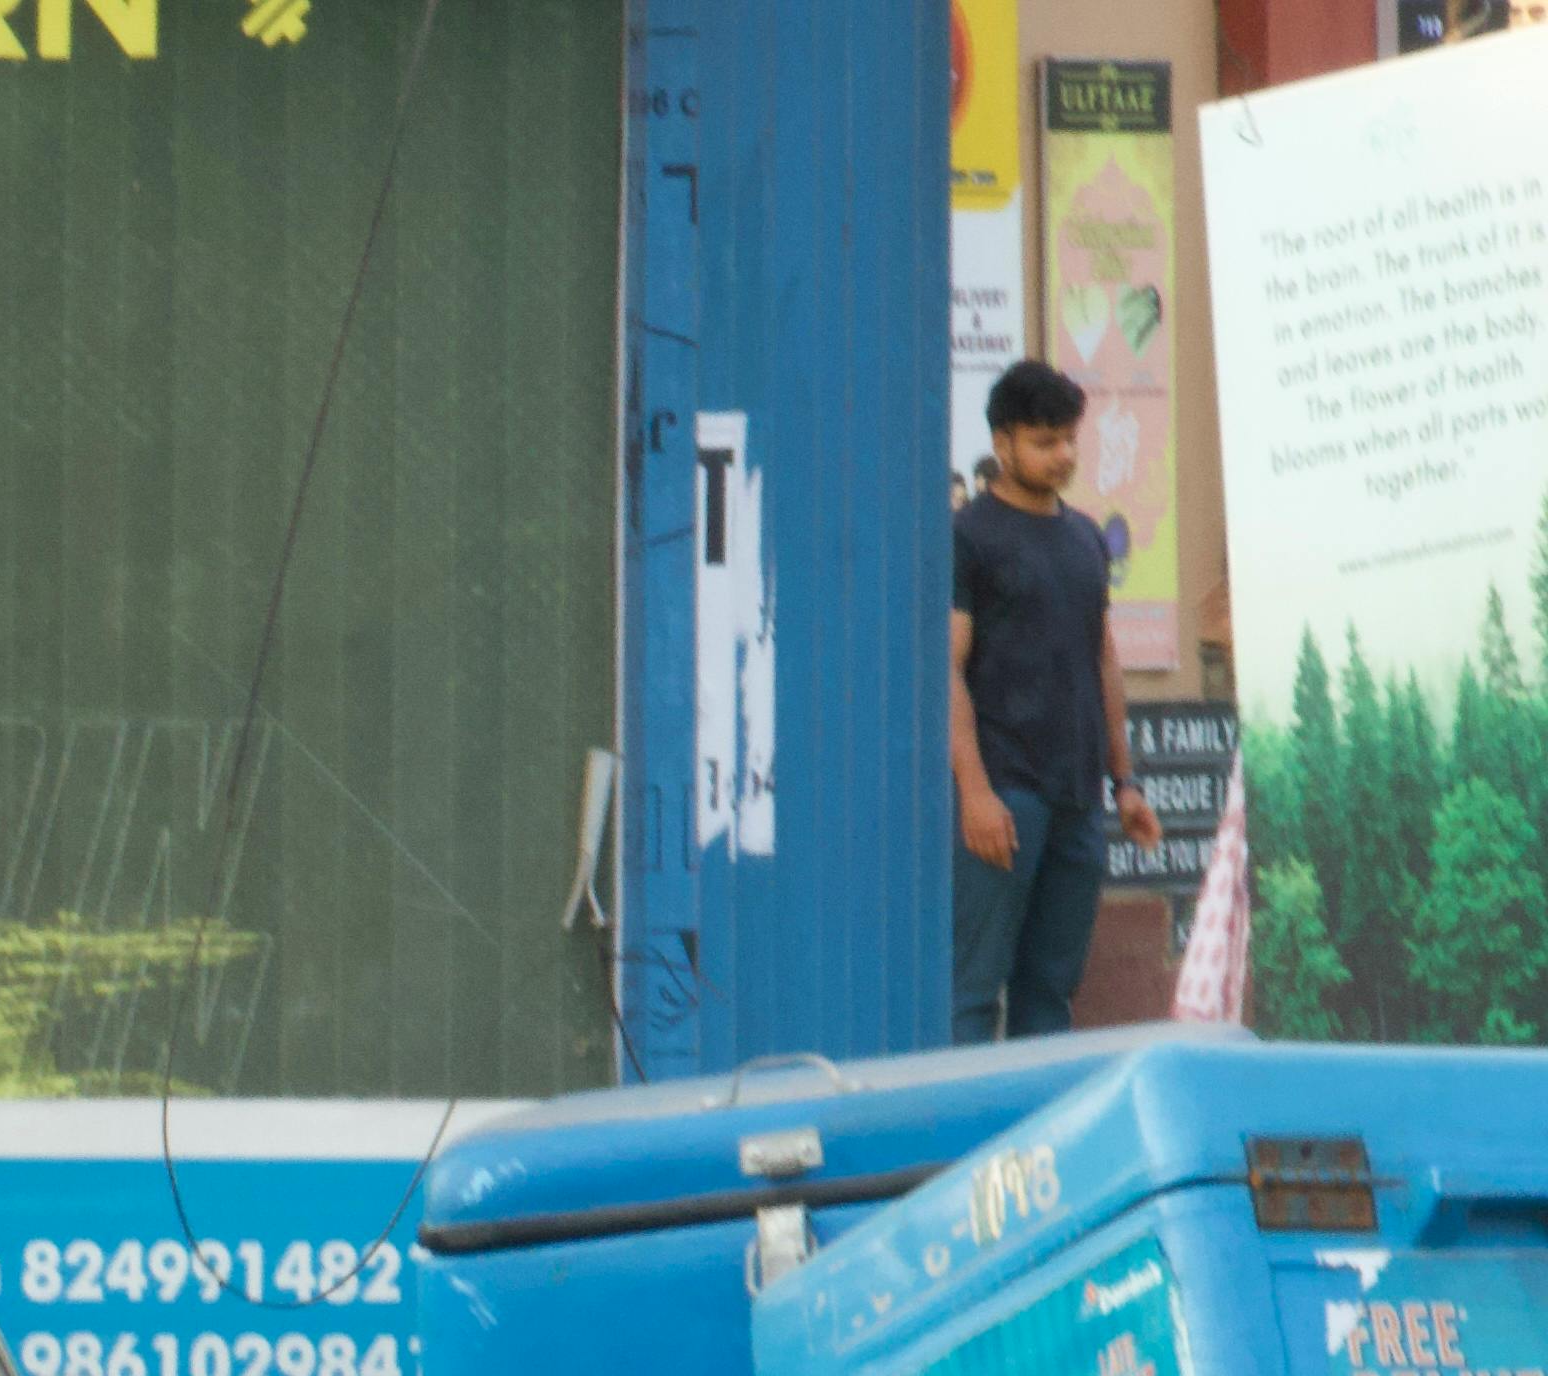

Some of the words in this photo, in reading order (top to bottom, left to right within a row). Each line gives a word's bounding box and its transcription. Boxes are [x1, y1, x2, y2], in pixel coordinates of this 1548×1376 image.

[1313, 218, 1356, 250] root
[1363, 205, 1385, 239] of
[1392, 195, 1420, 231] all
[1425, 181, 1493, 219] health
[1499, 182, 1517, 207] is
[1521, 176, 1544, 199] in
[1264, 274, 1300, 304] the
[1374, 247, 1412, 279] The
[1417, 232, 1470, 268] trunk
[1476, 220, 1500, 255] of
[1505, 219, 1522, 248] it
[1273, 321, 1294, 347] in
[1397, 286, 1438, 316] The
[1443, 263, 1543, 308] branches
[1277, 356, 1319, 389] and
[1325, 343, 1393, 378] leaves
[1400, 332, 1437, 360] are
[1443, 320, 1479, 348] the
[1305, 393, 1344, 424] The
[1349, 379, 1418, 415] flower
[1424, 366, 1447, 398] of
[1454, 350, 1525, 391] health
[1270, 439, 1348, 478] blooms
[1353, 422, 1412, 459] when
[1417, 408, 1445, 443] all
[1450, 400, 1509, 446] parts
[20, 1238, 429, 1306] 824991482
